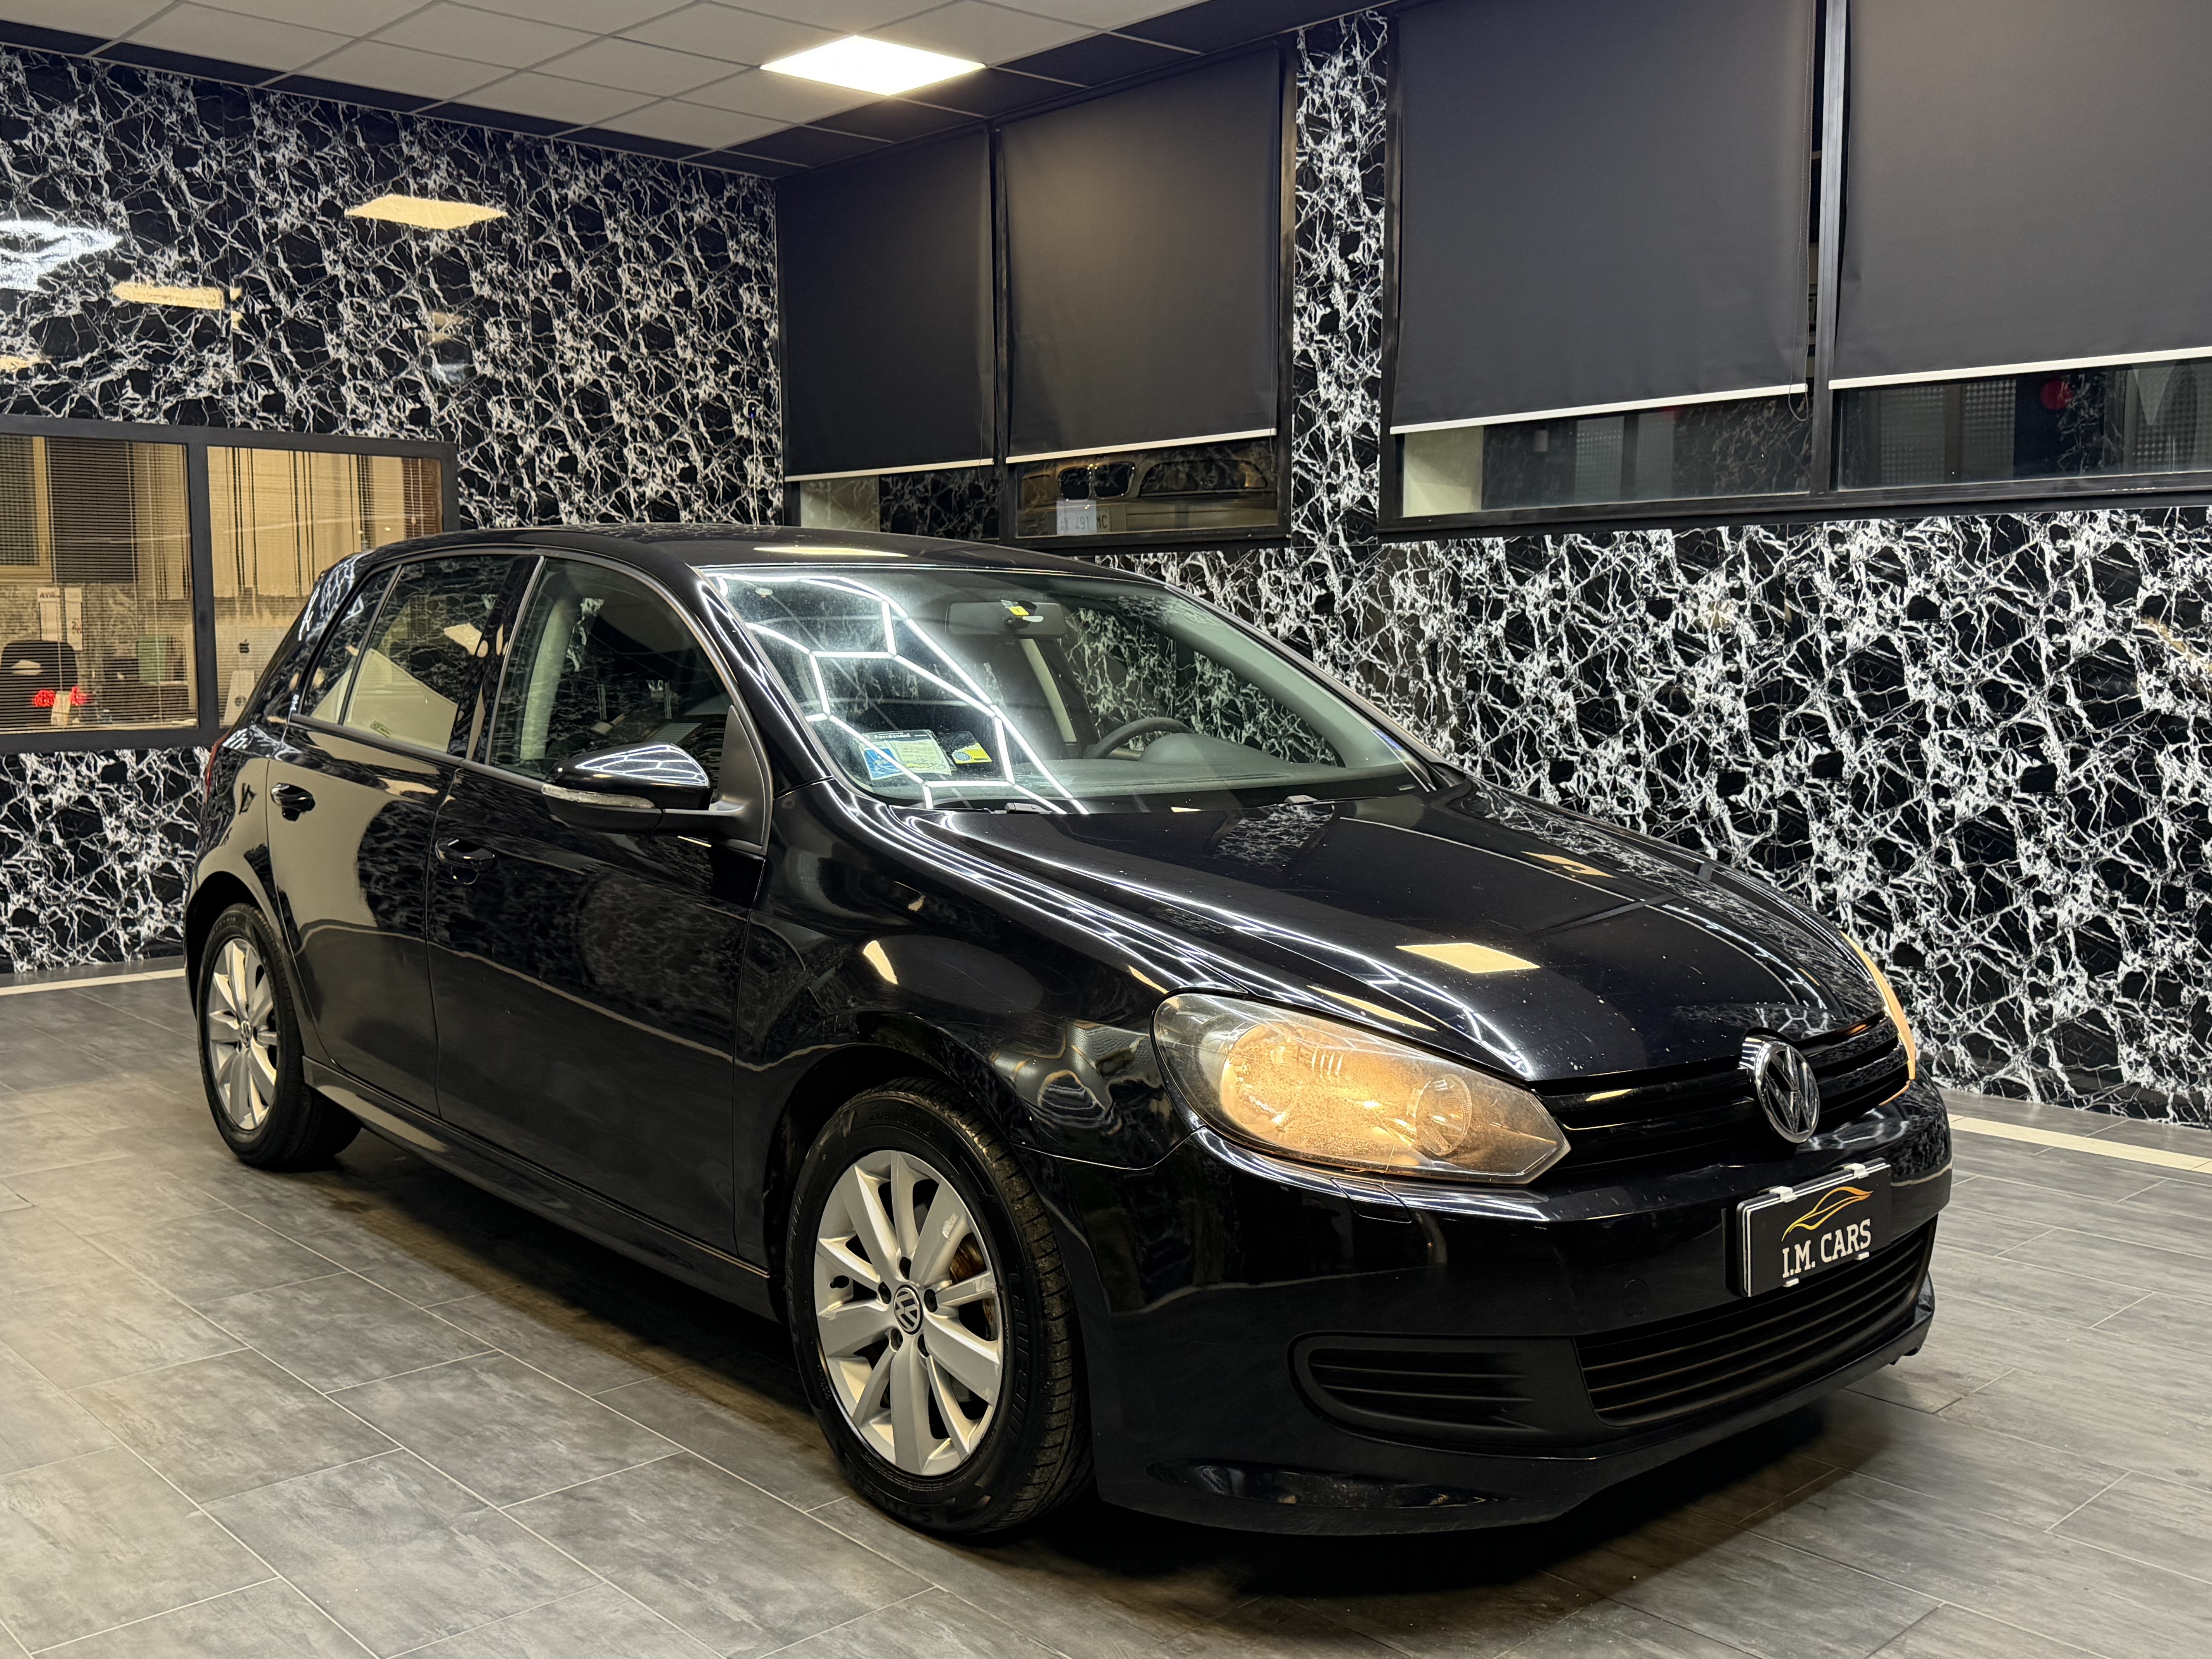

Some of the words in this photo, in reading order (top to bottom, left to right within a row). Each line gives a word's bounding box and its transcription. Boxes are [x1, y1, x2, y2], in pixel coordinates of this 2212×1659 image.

[1755, 1041, 1820, 1143] VW
[1783, 1240, 1816, 1278] I.M.
[1821, 1218, 1871, 1263] CARS
[894, 1286, 922, 1333] VW
